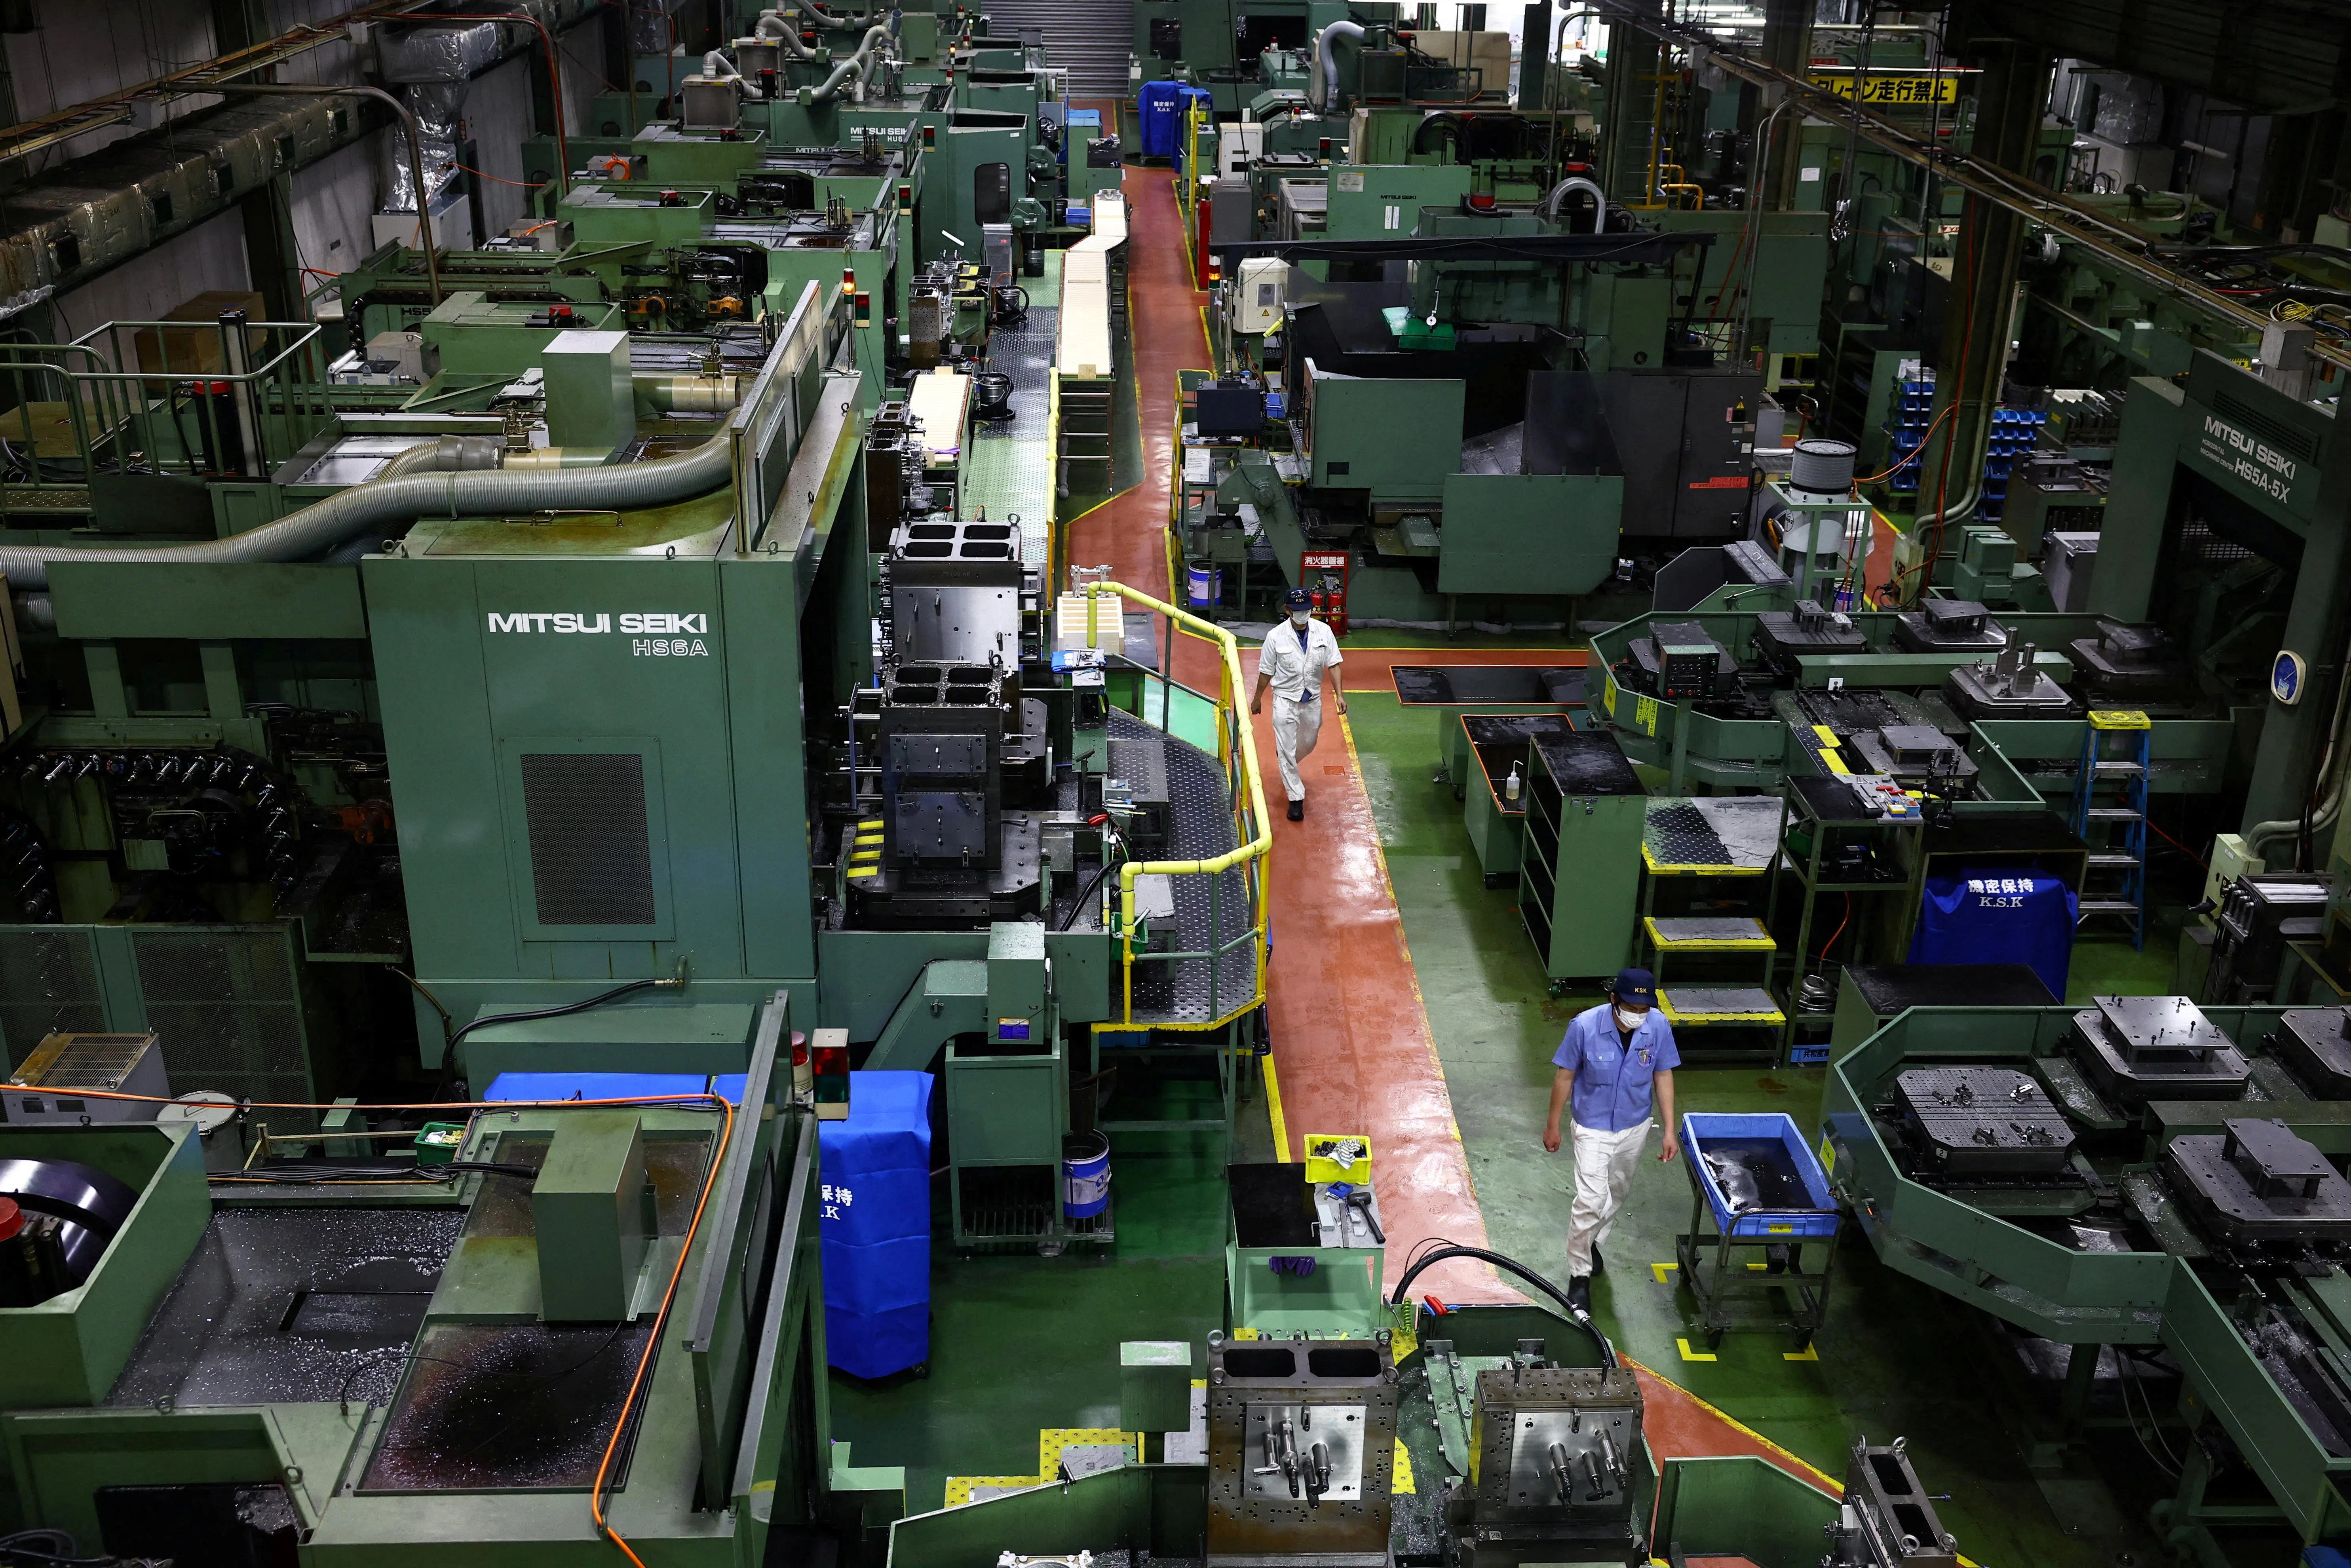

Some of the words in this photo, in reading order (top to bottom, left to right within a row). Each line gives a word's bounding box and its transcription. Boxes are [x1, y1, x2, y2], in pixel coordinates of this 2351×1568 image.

[2202, 438, 2224, 455] HORIZONTAL
[2205, 416, 2255, 456] MITSUI
[2256, 444, 2296, 480] SEIKI
[1305, 556, 1345, 565] 消火器置場
[488, 613, 610, 633] MITSUI
[619, 613, 707, 633] SEIKI
[633, 639, 709, 656] HS6A
[1968, 878, 2034, 894] 機密保持
[1978, 897, 2024, 908] K.S.K
[821, 1185, 853, 1207] 保持
